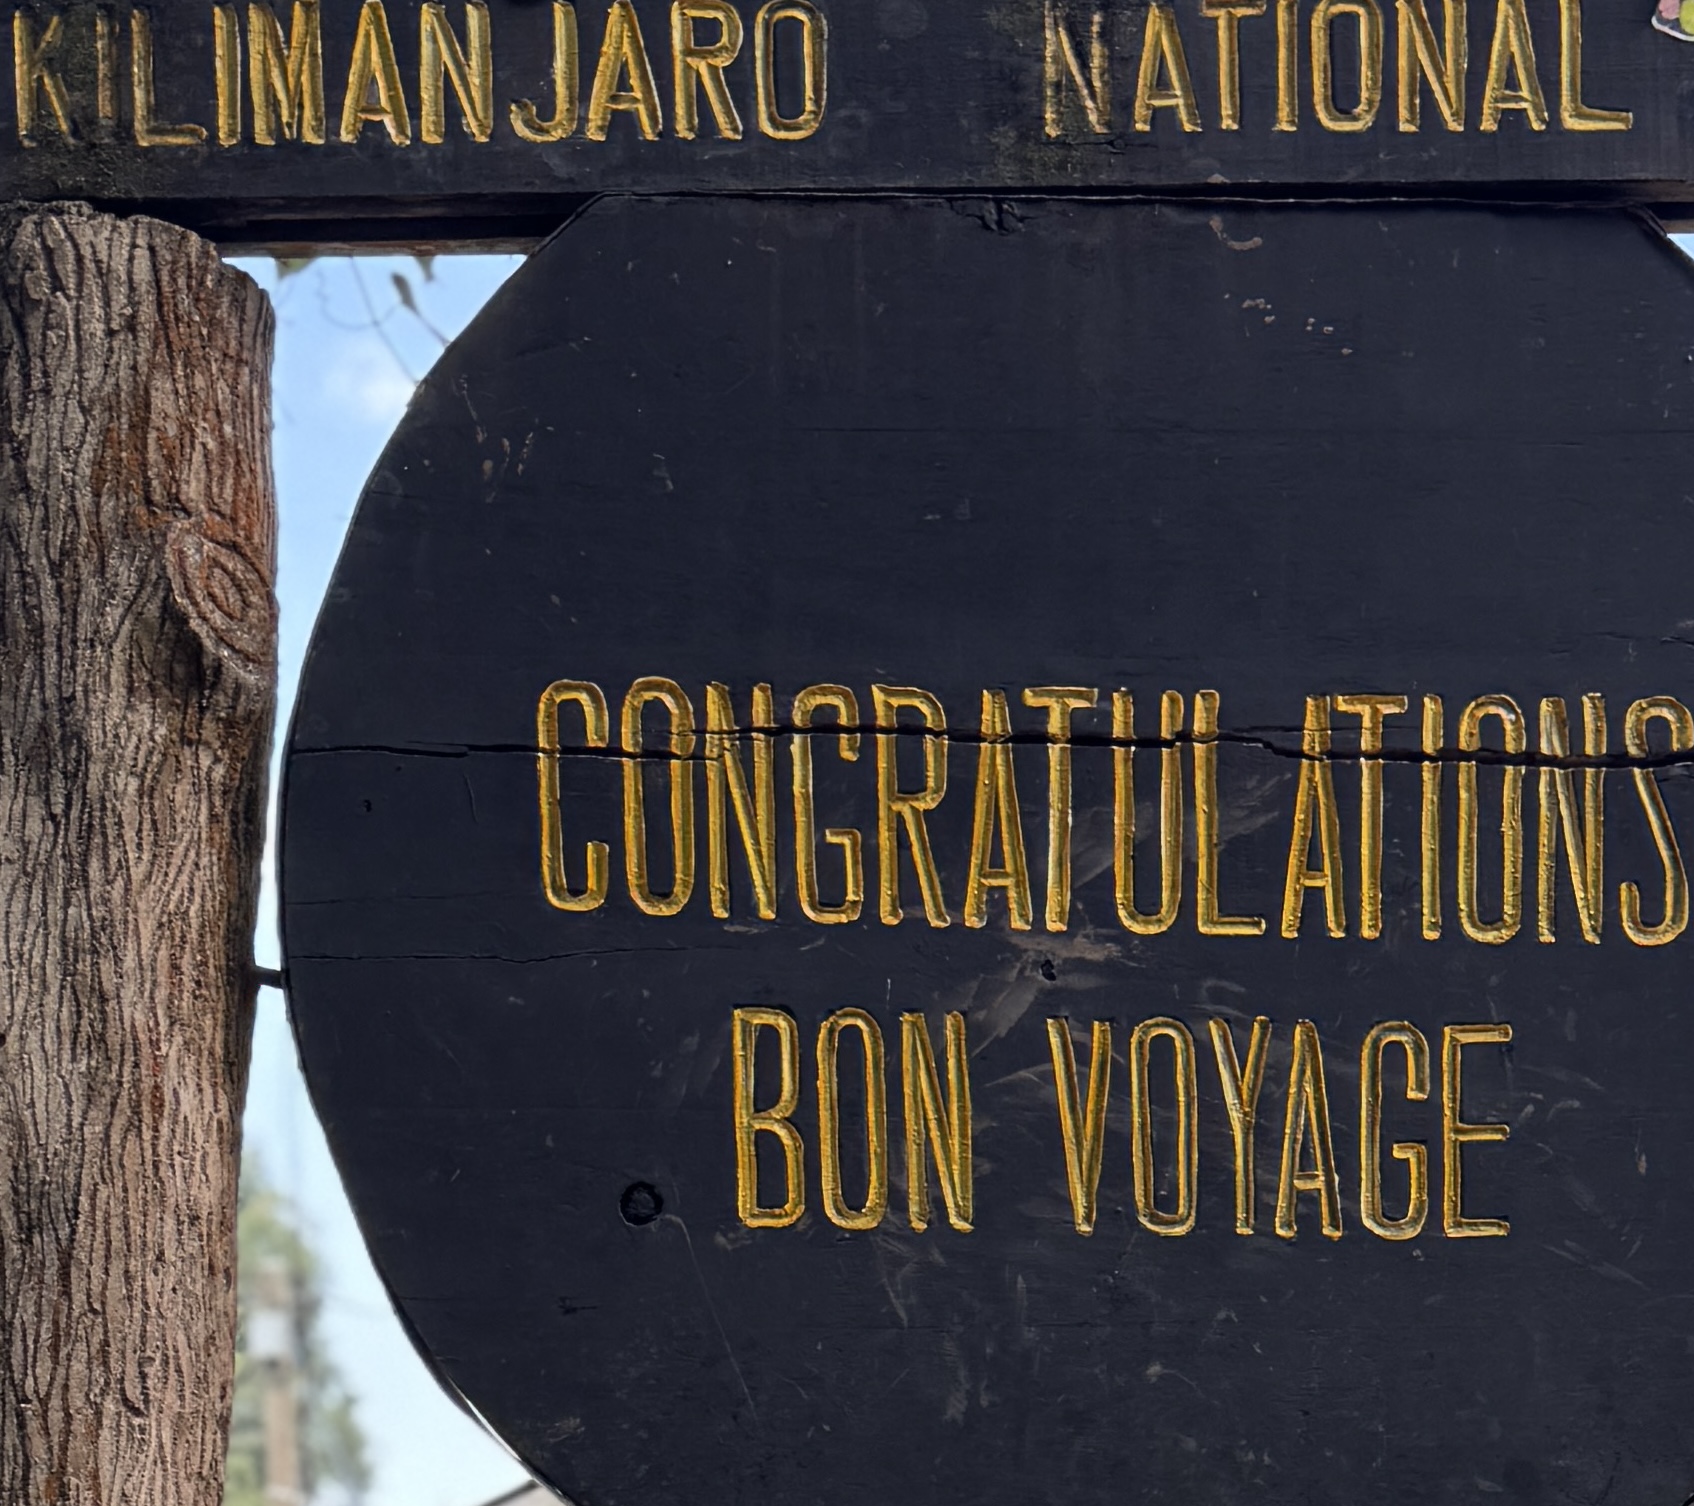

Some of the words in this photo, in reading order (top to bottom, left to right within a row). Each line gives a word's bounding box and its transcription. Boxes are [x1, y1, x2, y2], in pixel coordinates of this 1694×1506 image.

[13, 0, 830, 147] KILIMANJARO
[1043, 0, 1634, 132] NATIONAL
[731, 1006, 977, 1232] BON
[1047, 1015, 1514, 1241] VOYAGE
